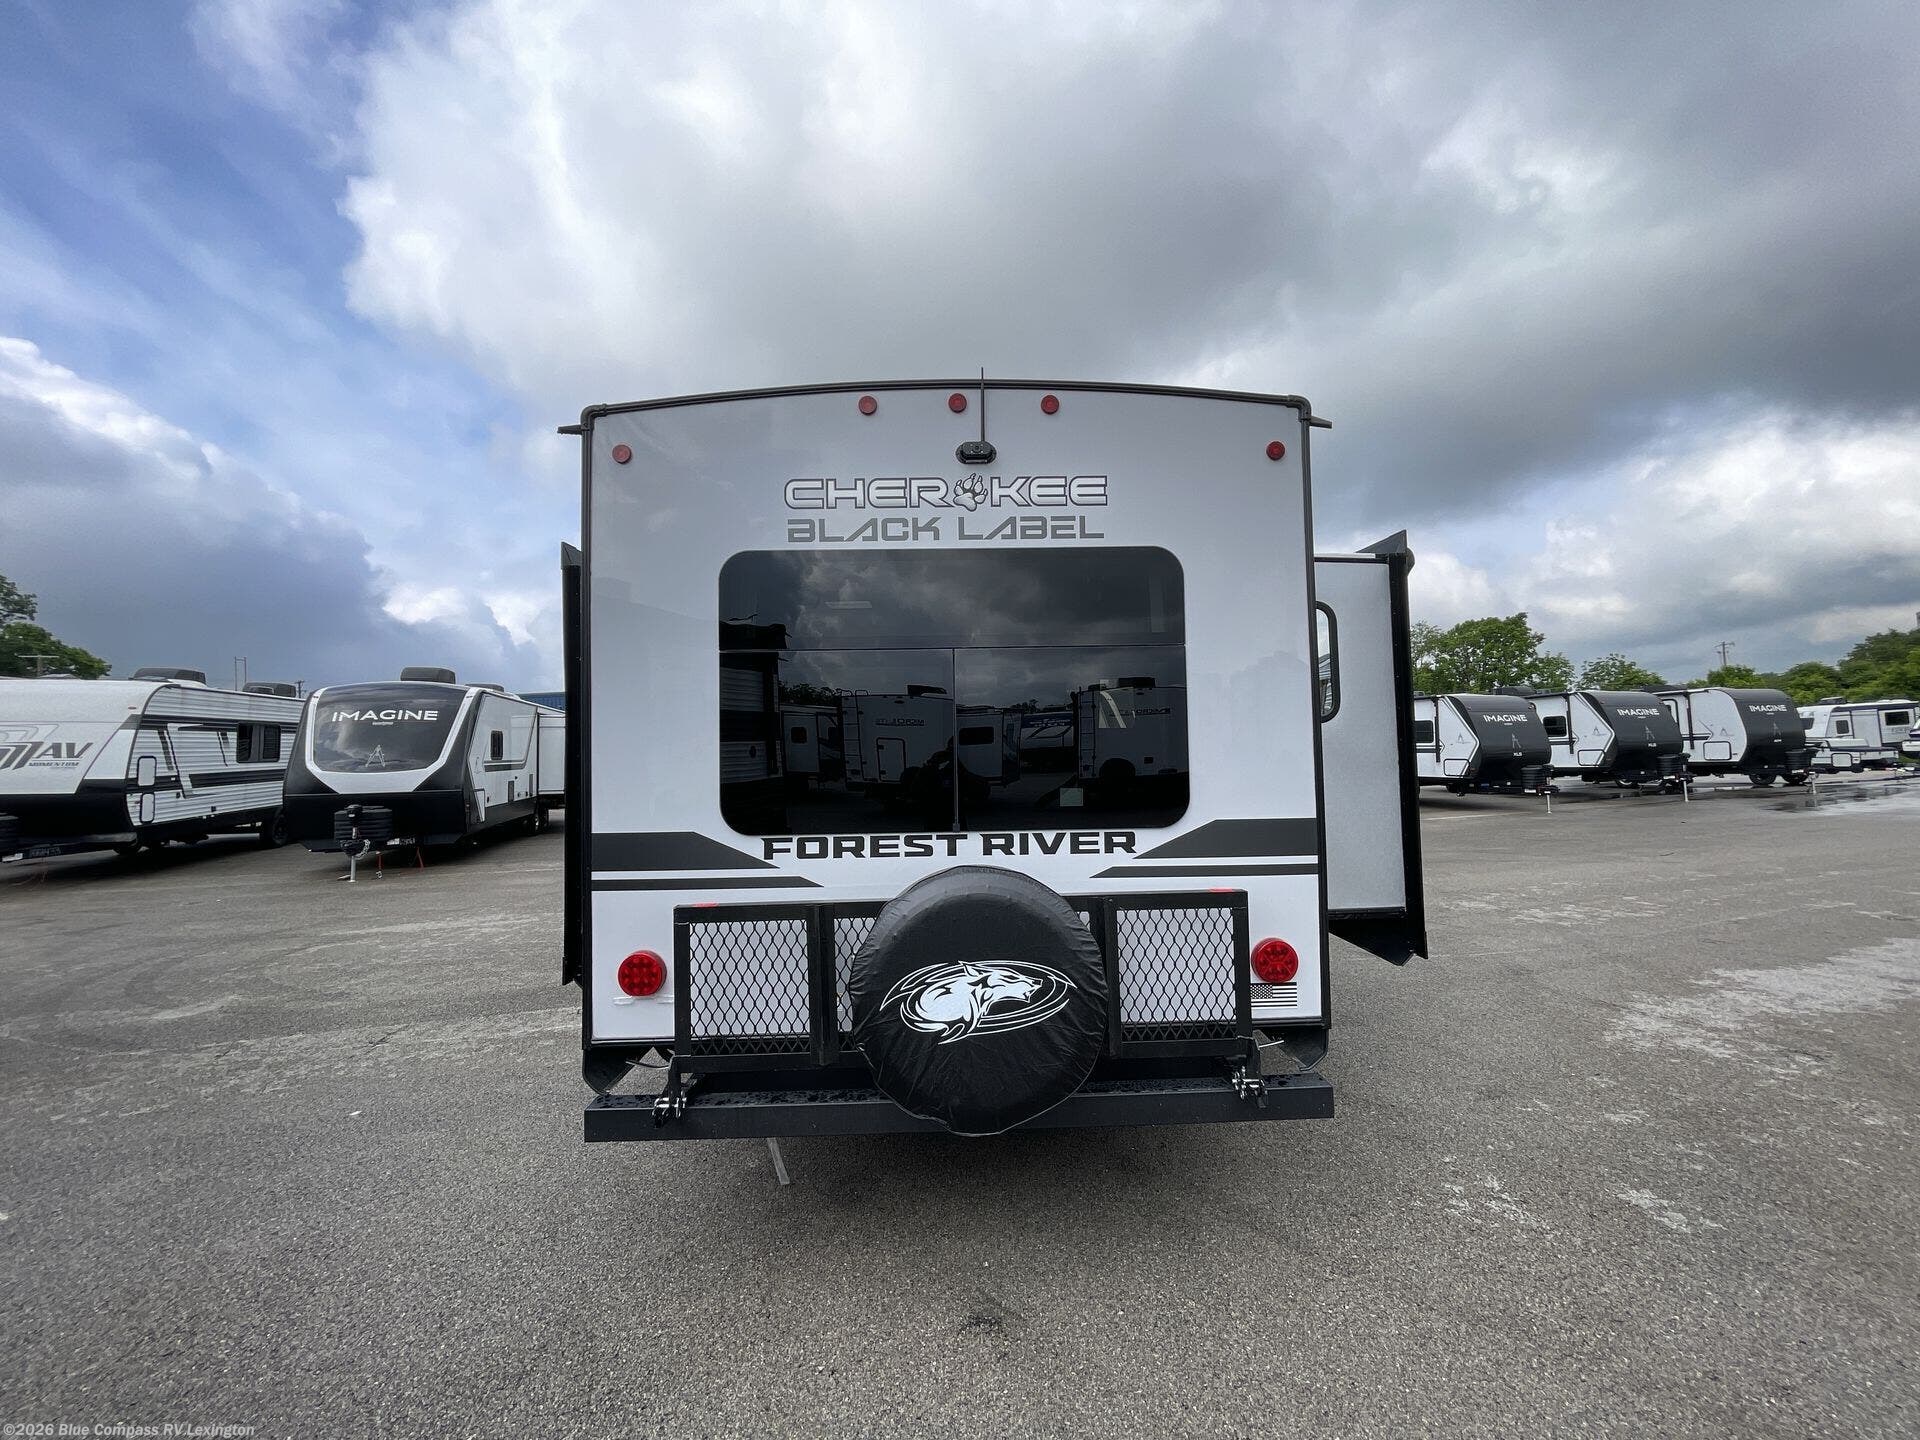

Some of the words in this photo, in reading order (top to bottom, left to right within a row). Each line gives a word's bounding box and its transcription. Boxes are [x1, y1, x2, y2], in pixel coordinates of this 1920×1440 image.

[787, 517, 942, 543] BLACK
[958, 516, 1105, 540] LABEL
[1616, 708, 1660, 716] IMAGINE
[1749, 704, 1788, 712] IMAGINE
[332, 710, 439, 722] IMAGINE
[1483, 714, 1528, 722] IMAGINE
[760, 834, 968, 860] FOREST
[979, 831, 1137, 856] RIVER
